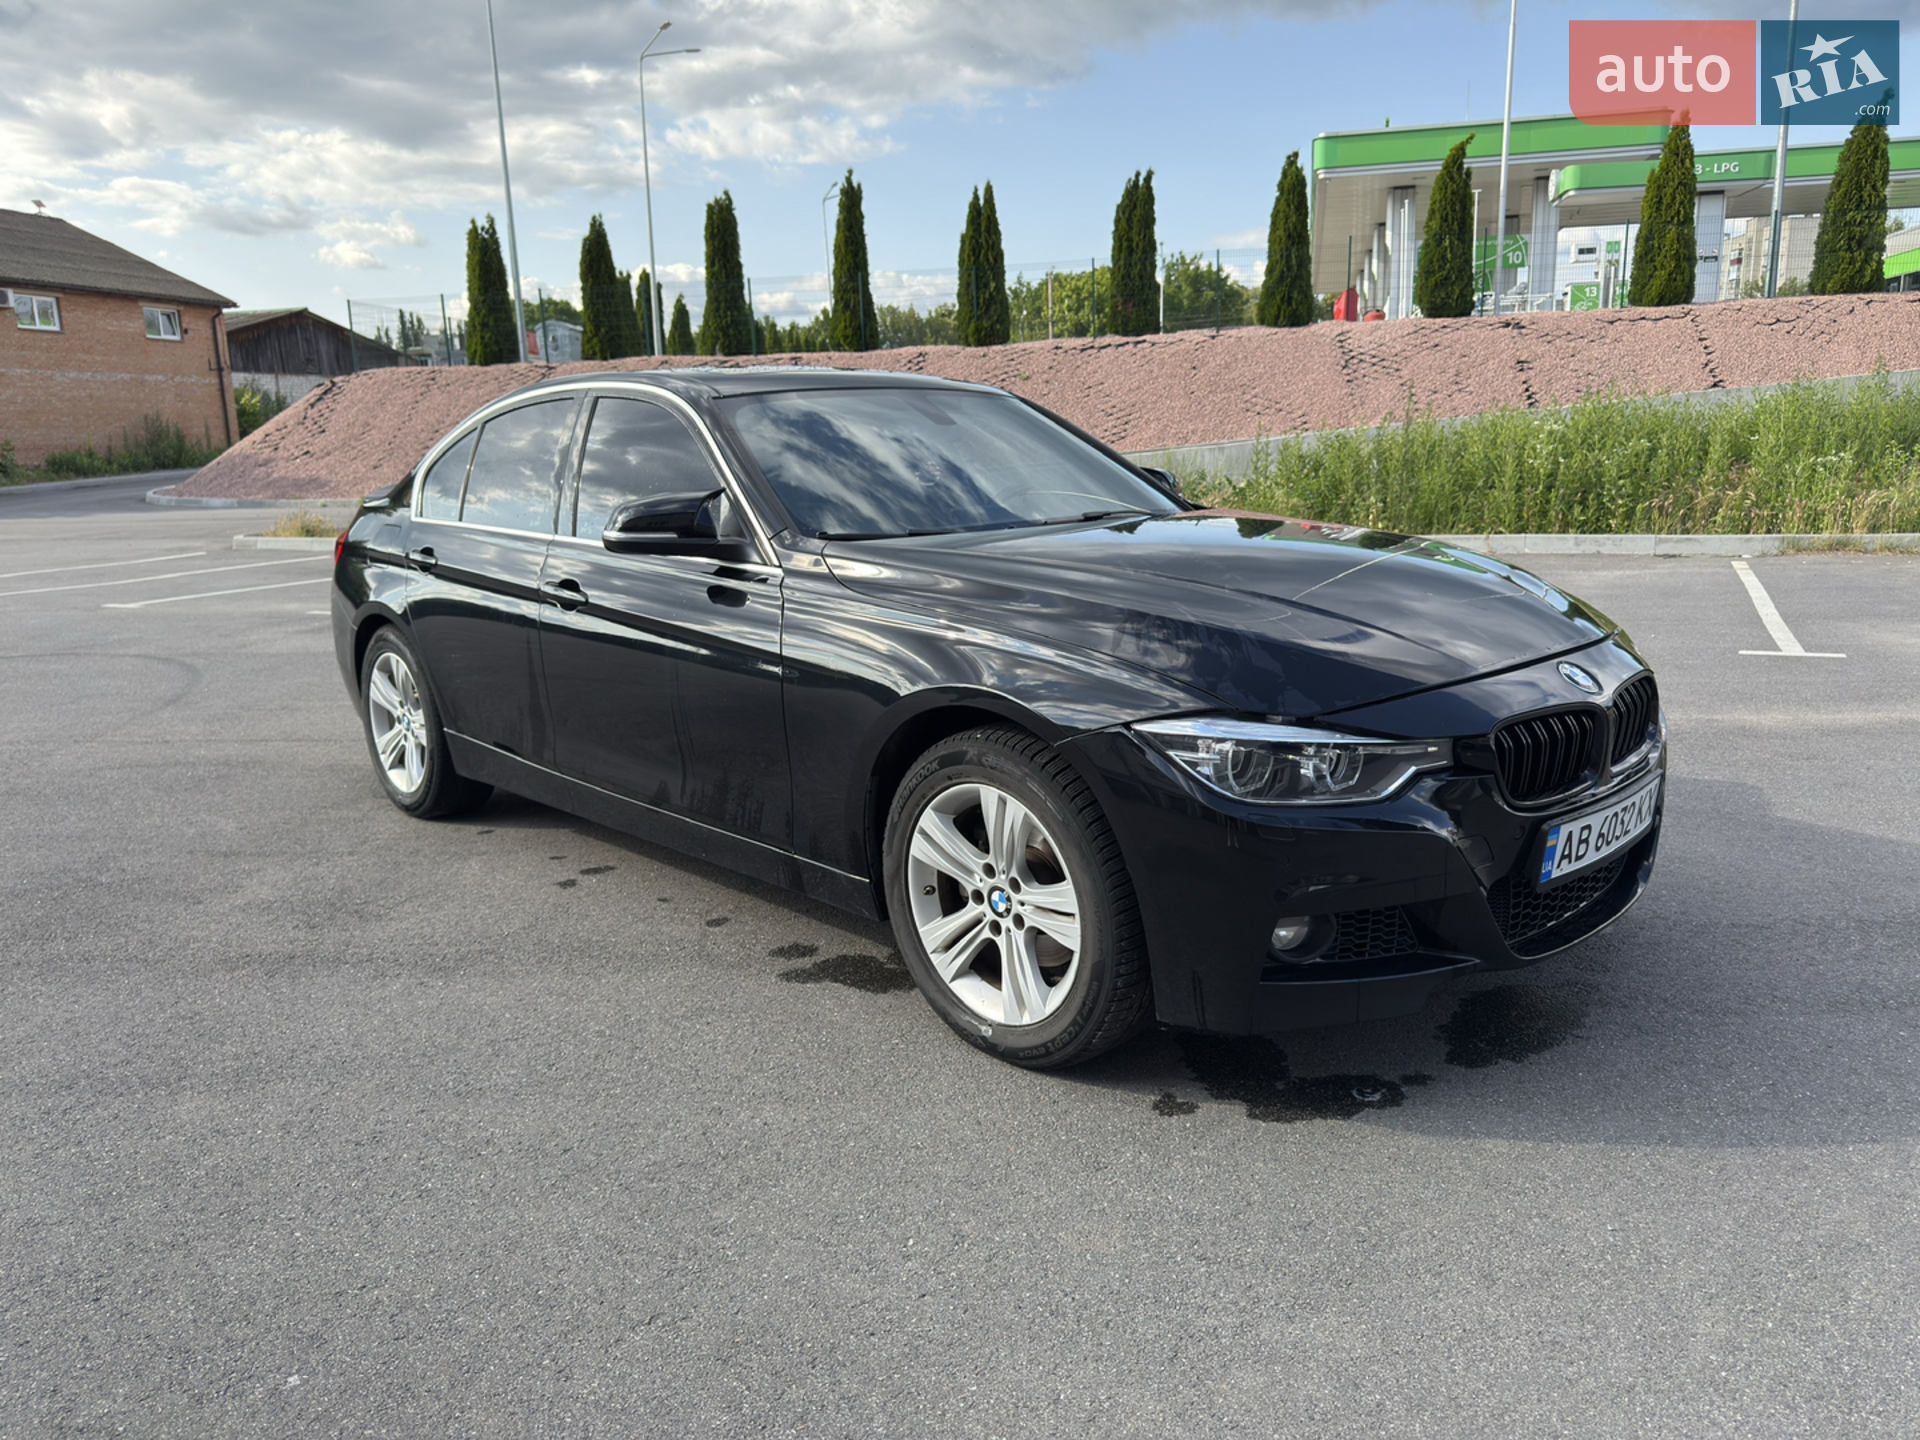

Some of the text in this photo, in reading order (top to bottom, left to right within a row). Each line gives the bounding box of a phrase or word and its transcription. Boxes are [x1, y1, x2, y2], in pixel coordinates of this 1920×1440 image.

[1714, 162, 1739, 174] LPG
[1506, 251, 1522, 264] 10
[1584, 286, 1598, 297] 13
[1556, 783, 1658, 869] AB 6032 KX
